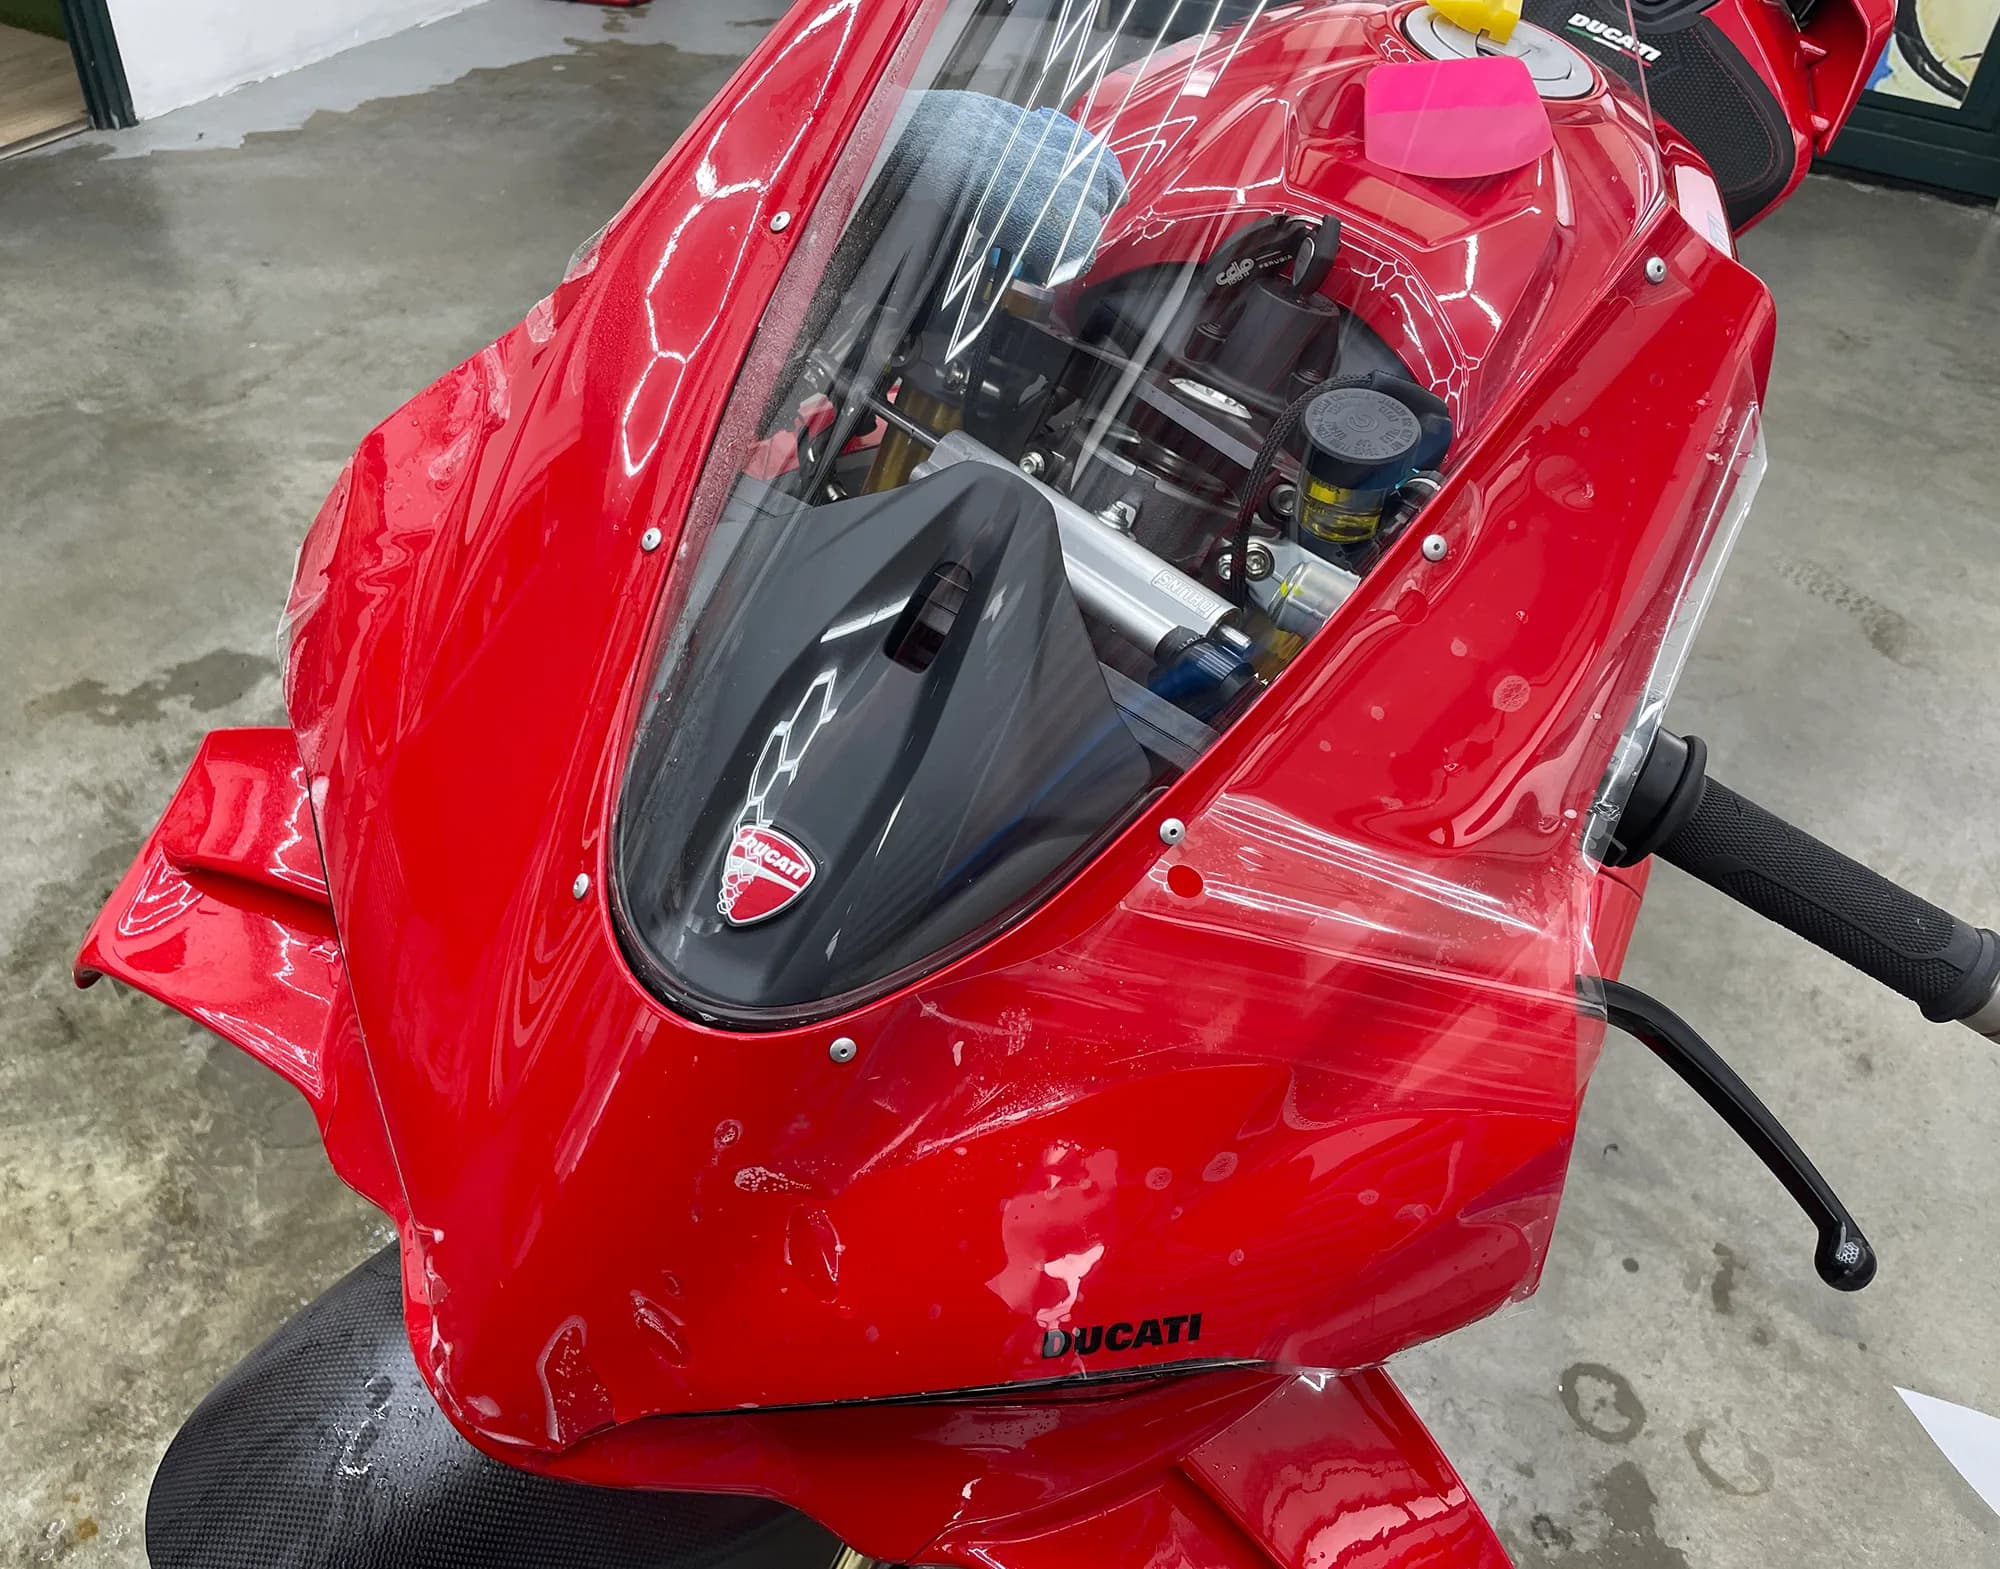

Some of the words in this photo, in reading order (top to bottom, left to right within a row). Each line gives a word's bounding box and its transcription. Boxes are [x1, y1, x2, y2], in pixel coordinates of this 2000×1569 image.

[1568, 13, 1662, 62] DUCATI
[743, 836, 806, 880] DUCATI
[1042, 1313, 1202, 1359] DUCATI
